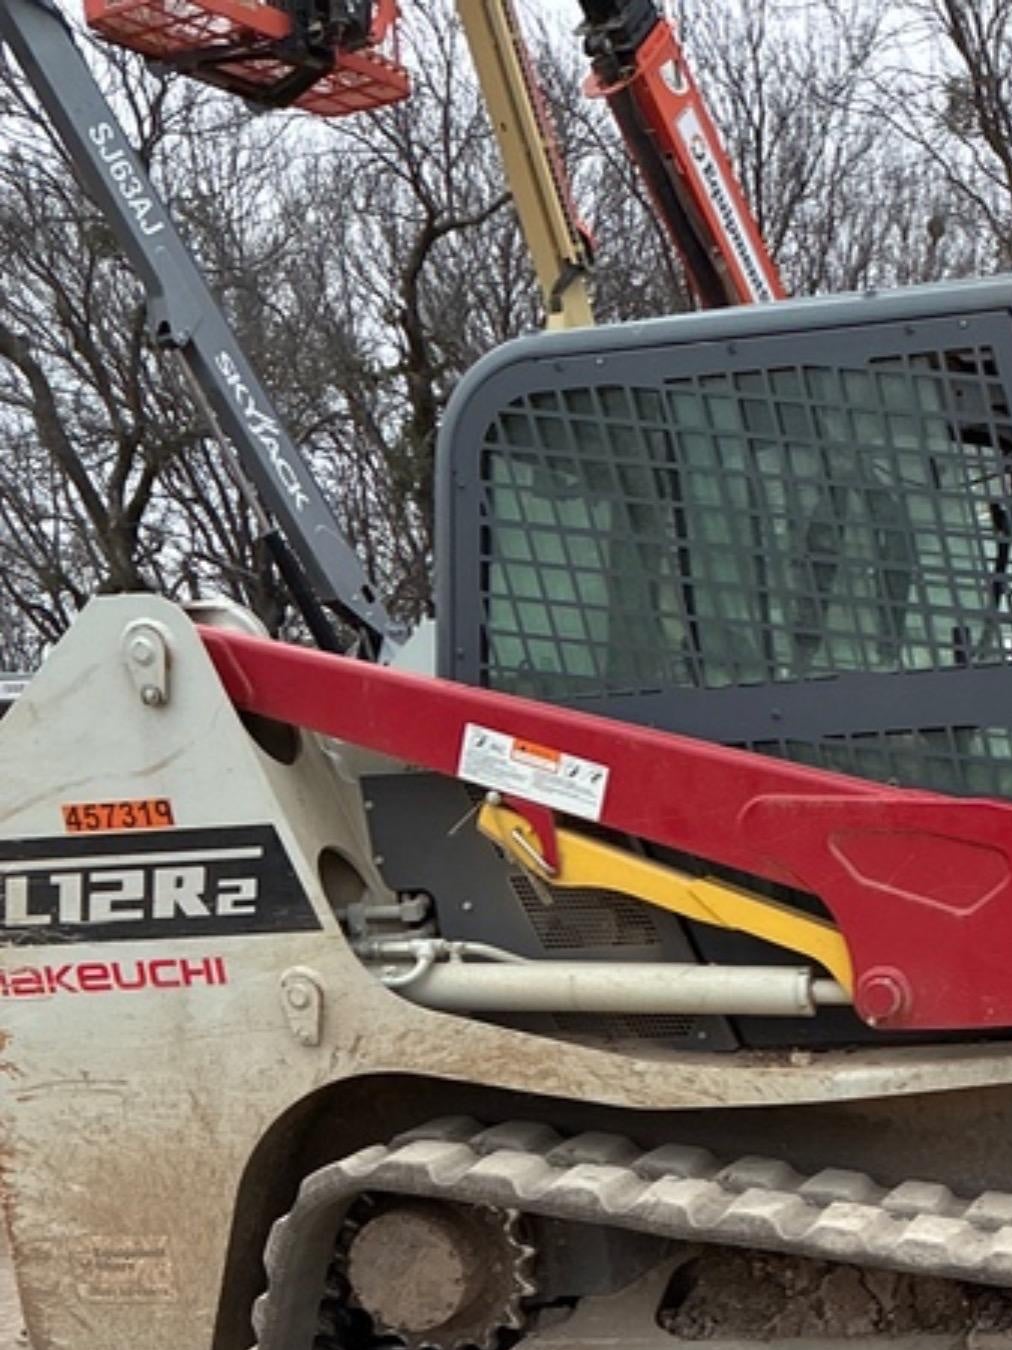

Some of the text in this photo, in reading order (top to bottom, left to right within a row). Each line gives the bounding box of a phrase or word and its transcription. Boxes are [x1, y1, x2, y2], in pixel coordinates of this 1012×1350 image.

[88, 122, 164, 235] SJ63AJ
[214, 351, 310, 511] SKYJACK
[64, 800, 175, 831] 457319
